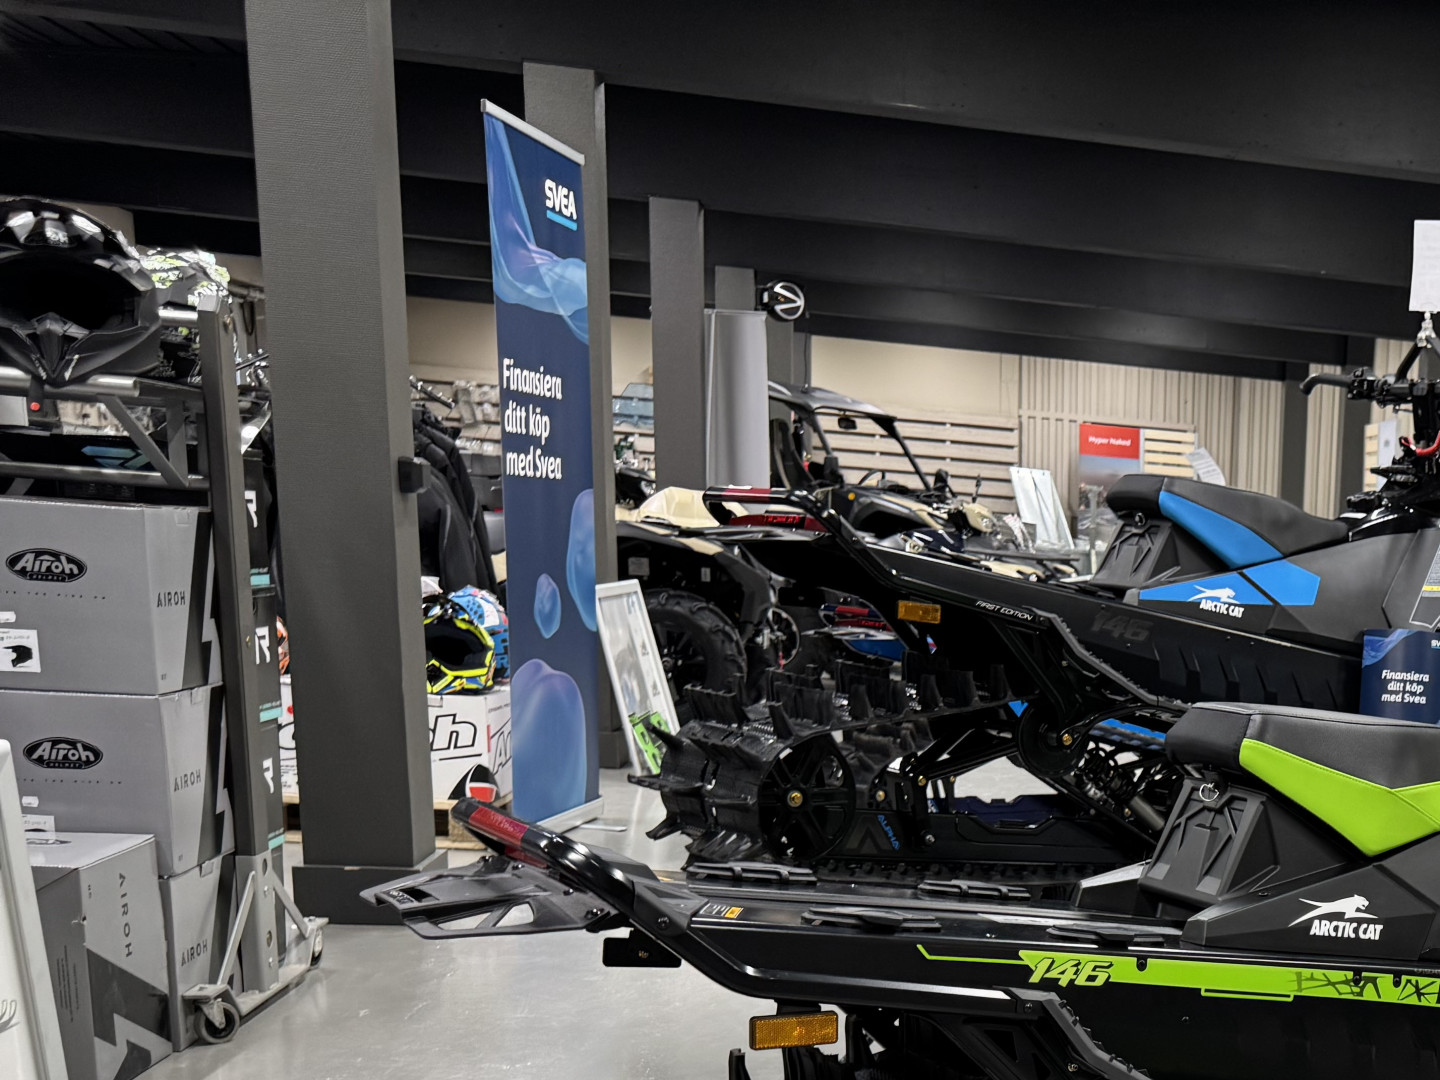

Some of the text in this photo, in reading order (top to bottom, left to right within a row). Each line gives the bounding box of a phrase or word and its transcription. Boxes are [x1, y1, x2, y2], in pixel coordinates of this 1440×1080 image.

[545, 179, 577, 220] SVEA
[503, 358, 562, 400] Finansiera
[504, 400, 550, 445] ditt köp
[1088, 436, 1109, 445] Hyper
[506, 446, 562, 480] med Svea
[13, 552, 80, 576] Airoh
[157, 591, 186, 608] AIROH
[976, 600, 1034, 621] FIRST EDITION
[1199, 599, 1245, 618] ARCTIC CAT
[1091, 611, 1154, 641] 146
[1381, 669, 1430, 682] Finansiera
[1387, 681, 1424, 694] ditt köp
[1381, 693, 1427, 704] med Svea
[31, 742, 96, 762] Airoh
[173, 768, 202, 792] AIROH
[119, 873, 133, 958] AIROH
[1310, 919, 1384, 941] ARCTIC CAT
[181, 939, 208, 967] AIROH
[1028, 957, 1113, 987] 146
